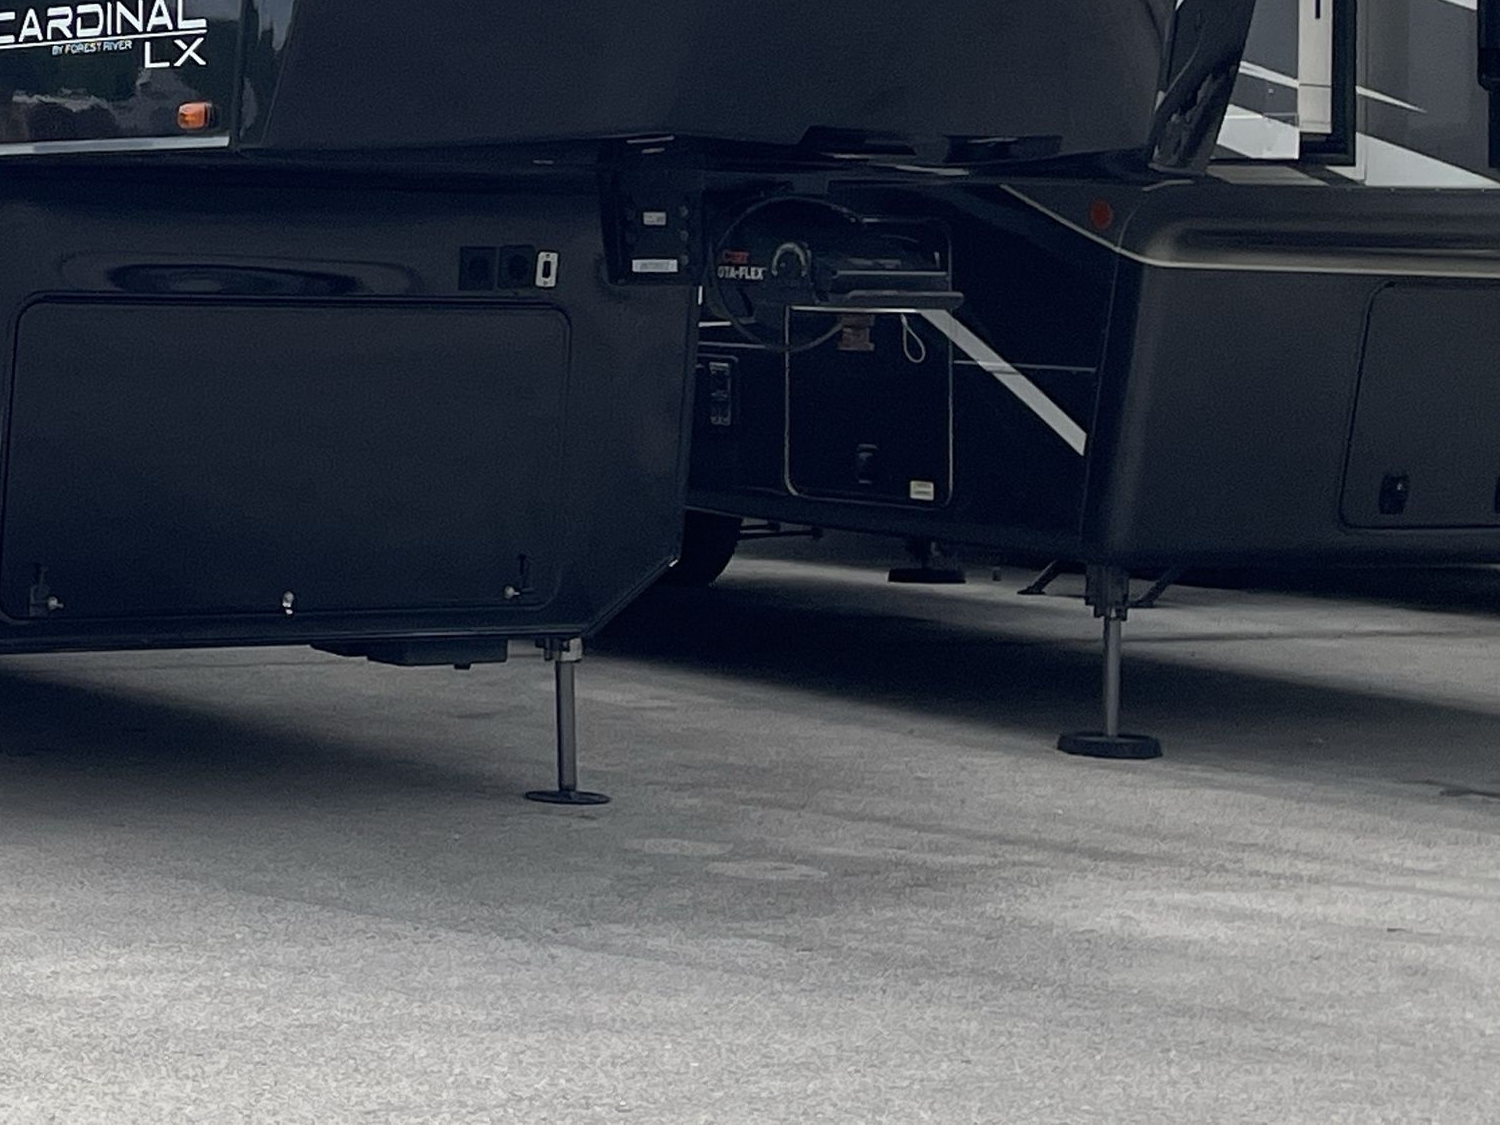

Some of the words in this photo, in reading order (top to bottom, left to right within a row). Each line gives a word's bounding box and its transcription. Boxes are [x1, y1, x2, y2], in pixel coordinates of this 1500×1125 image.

[52, 45, 63, 55] BY
[64, 42, 101, 54] FOREST
[103, 40, 132, 52] RIVER
[144, 37, 207, 68] LX
